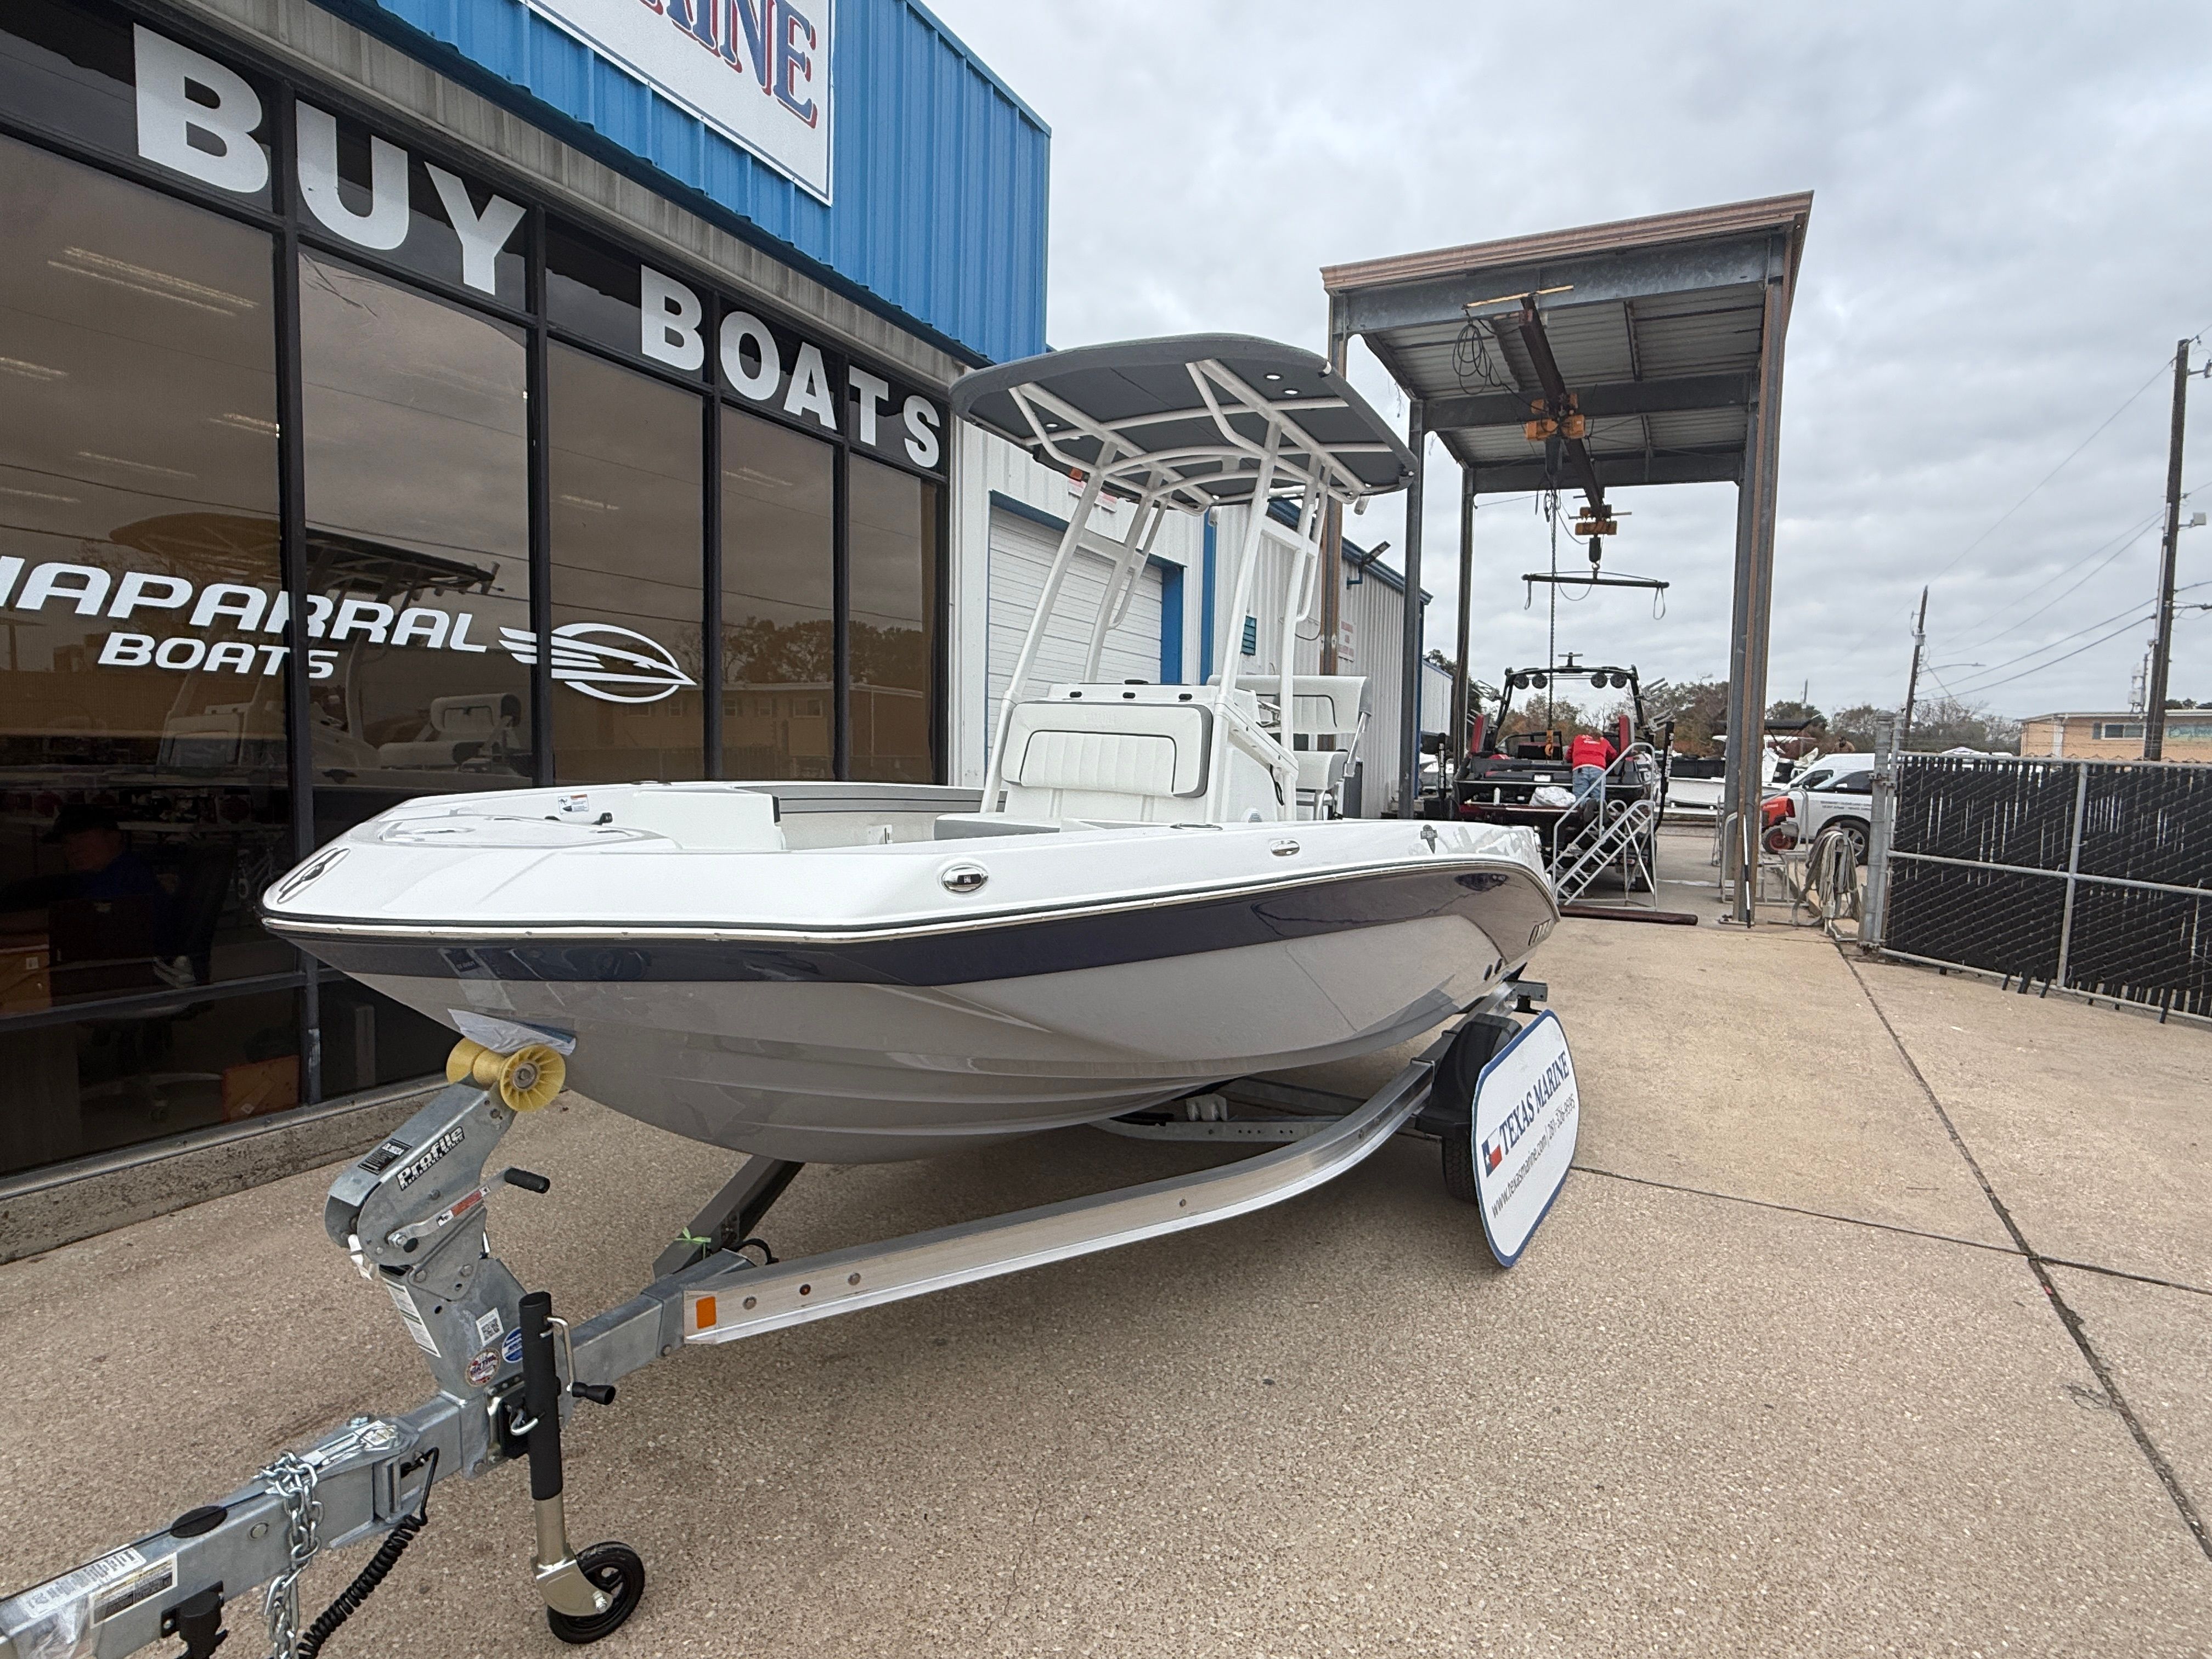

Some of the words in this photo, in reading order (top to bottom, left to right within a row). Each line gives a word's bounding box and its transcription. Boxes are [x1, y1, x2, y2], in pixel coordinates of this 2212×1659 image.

[133, 22, 527, 296] BUY
[640, 264, 941, 468] BOATS
[98, 631, 338, 679] BOATS
[1499, 1091, 1534, 1155] TEXAS
[1533, 1049, 1570, 1114] MARINE
[397, 1127, 463, 1186] Profile
